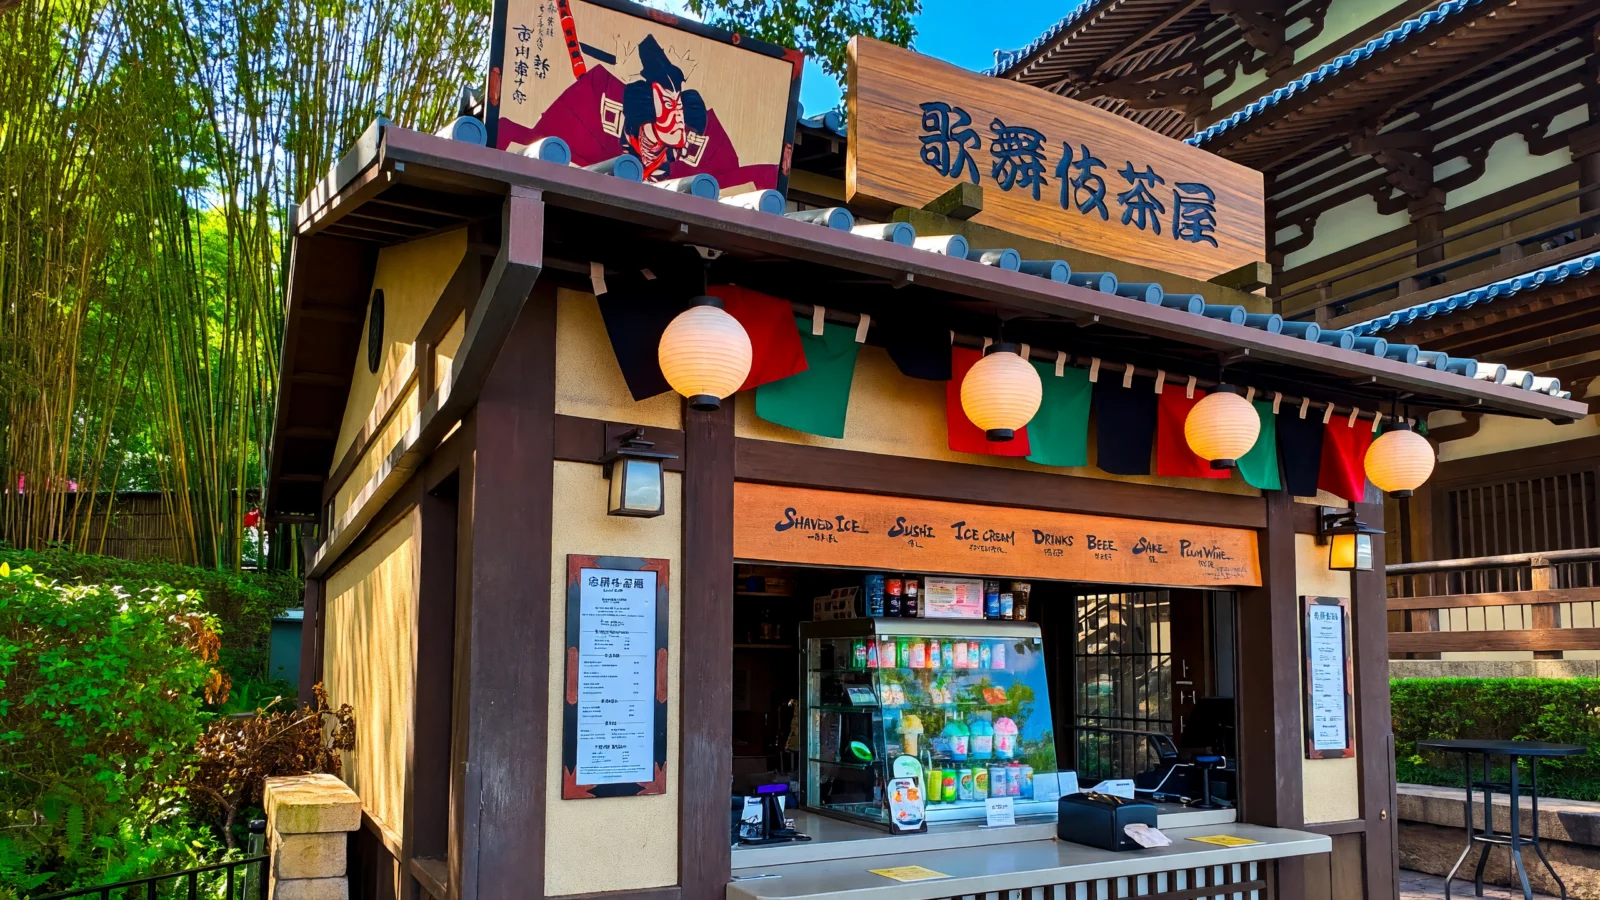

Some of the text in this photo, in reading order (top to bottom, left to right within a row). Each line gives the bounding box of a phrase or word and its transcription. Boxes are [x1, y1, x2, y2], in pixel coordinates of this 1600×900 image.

[918, 101, 1218, 248] 歌舞伎茶屋
[835, 515, 869, 534] ICE
[888, 516, 936, 538] SUSHI
[951, 521, 1015, 546] ICE CREAM
[1031, 529, 1074, 547] DRINKS
[1132, 536, 1168, 555] SAKE
